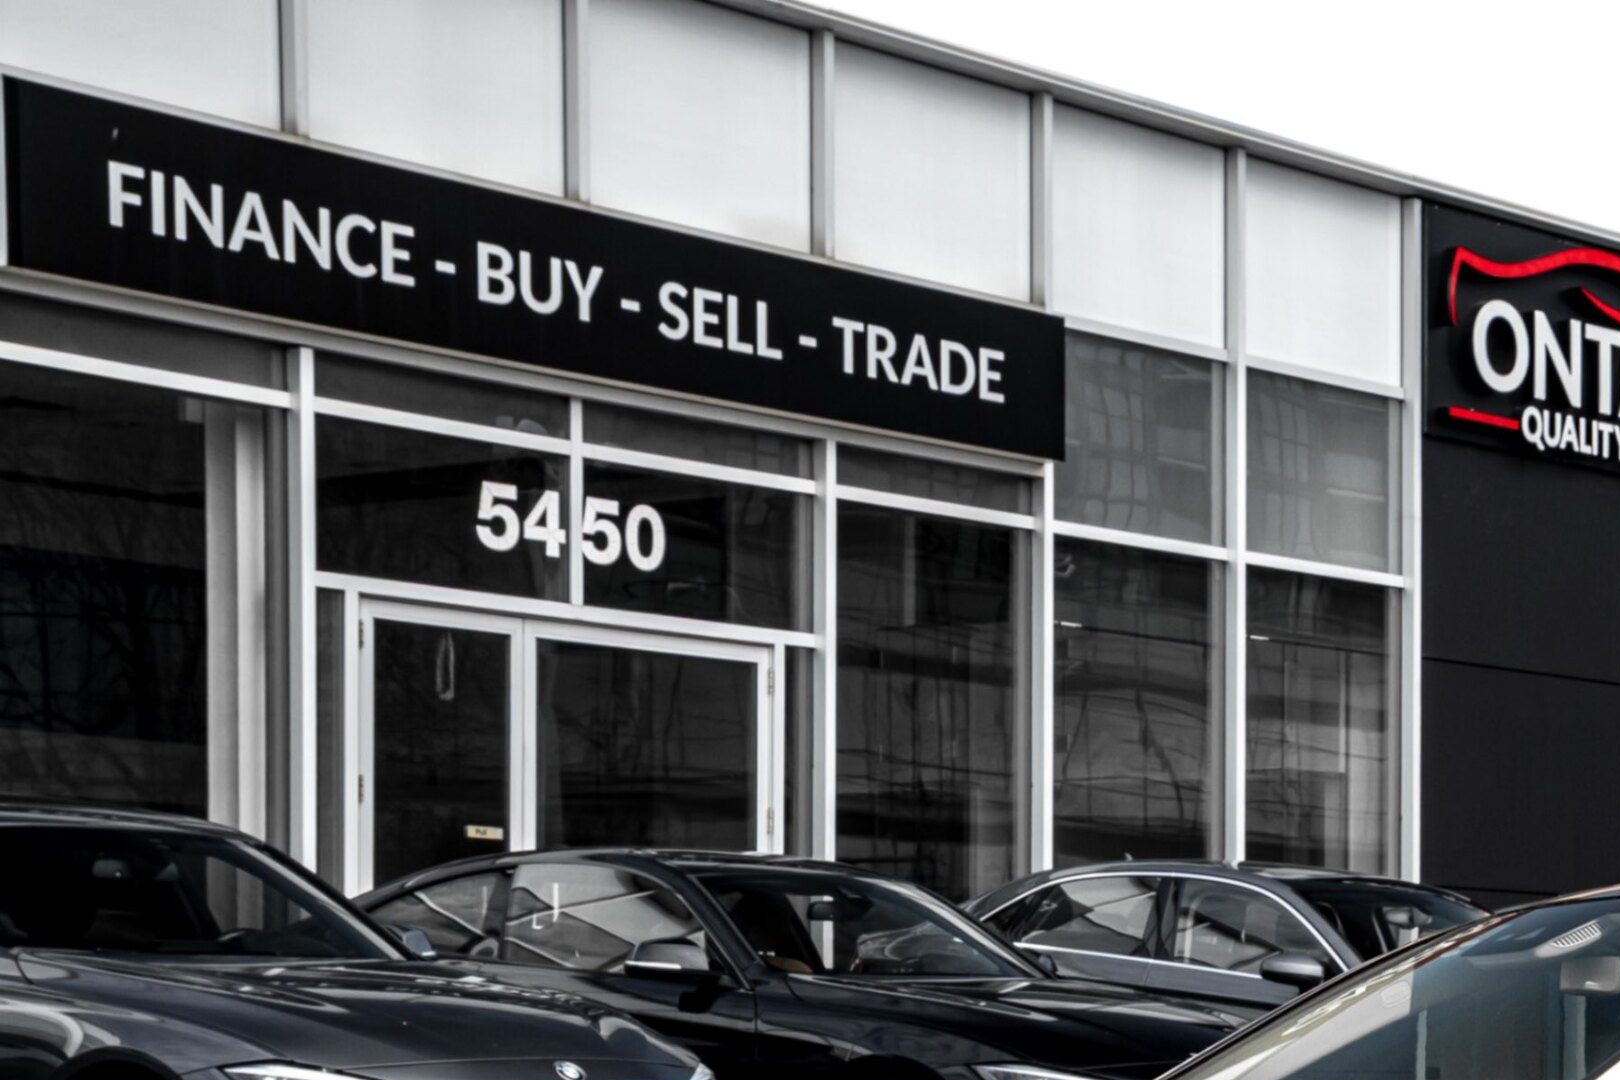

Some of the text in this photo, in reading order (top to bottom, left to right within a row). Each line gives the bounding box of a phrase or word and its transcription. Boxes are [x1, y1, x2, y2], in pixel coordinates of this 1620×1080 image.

[106, 159, 416, 288] FINANCE
[476, 241, 604, 323] BUY
[658, 281, 783, 360] SELL
[832, 316, 1005, 403] TRADE
[475, 480, 666, 572] 5450
